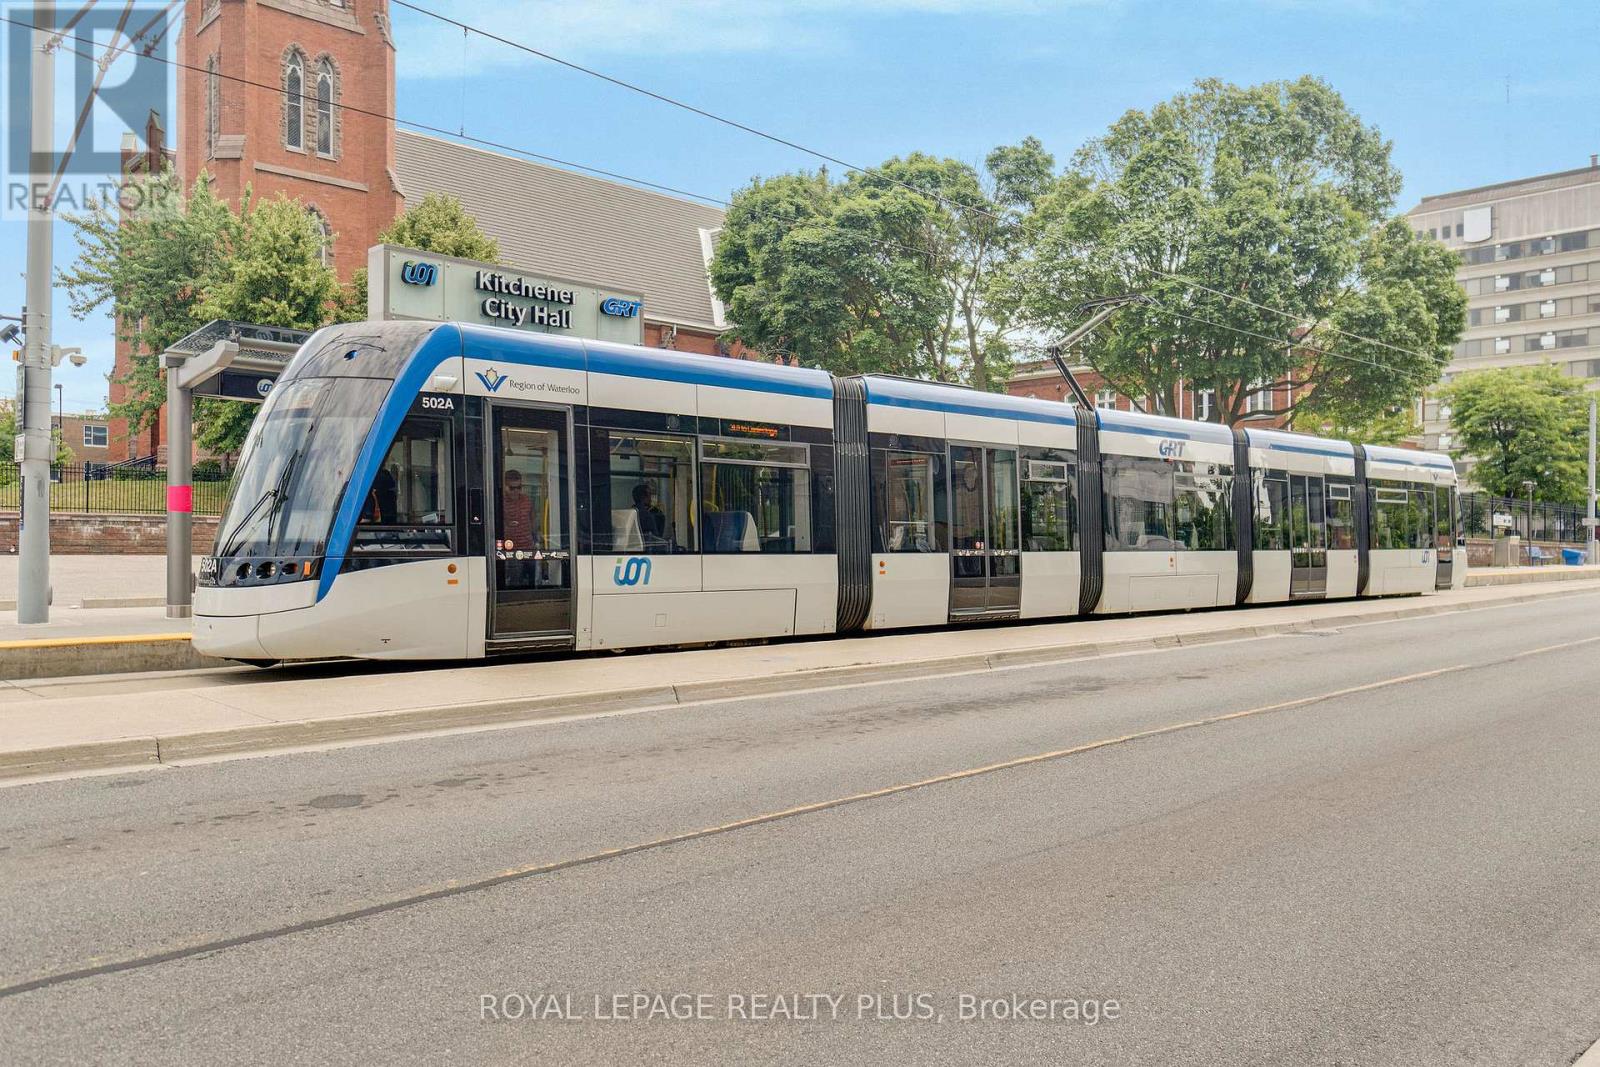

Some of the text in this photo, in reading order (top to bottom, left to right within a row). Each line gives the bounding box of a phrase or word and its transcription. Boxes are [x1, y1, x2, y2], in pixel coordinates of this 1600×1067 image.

[478, 271, 579, 305] Kitchener
[484, 297, 574, 329] City Hall
[602, 297, 642, 318] GRT
[509, 380, 580, 394] Region of Waterloo
[421, 397, 454, 410] 502A
[1159, 439, 1186, 456] GRT
